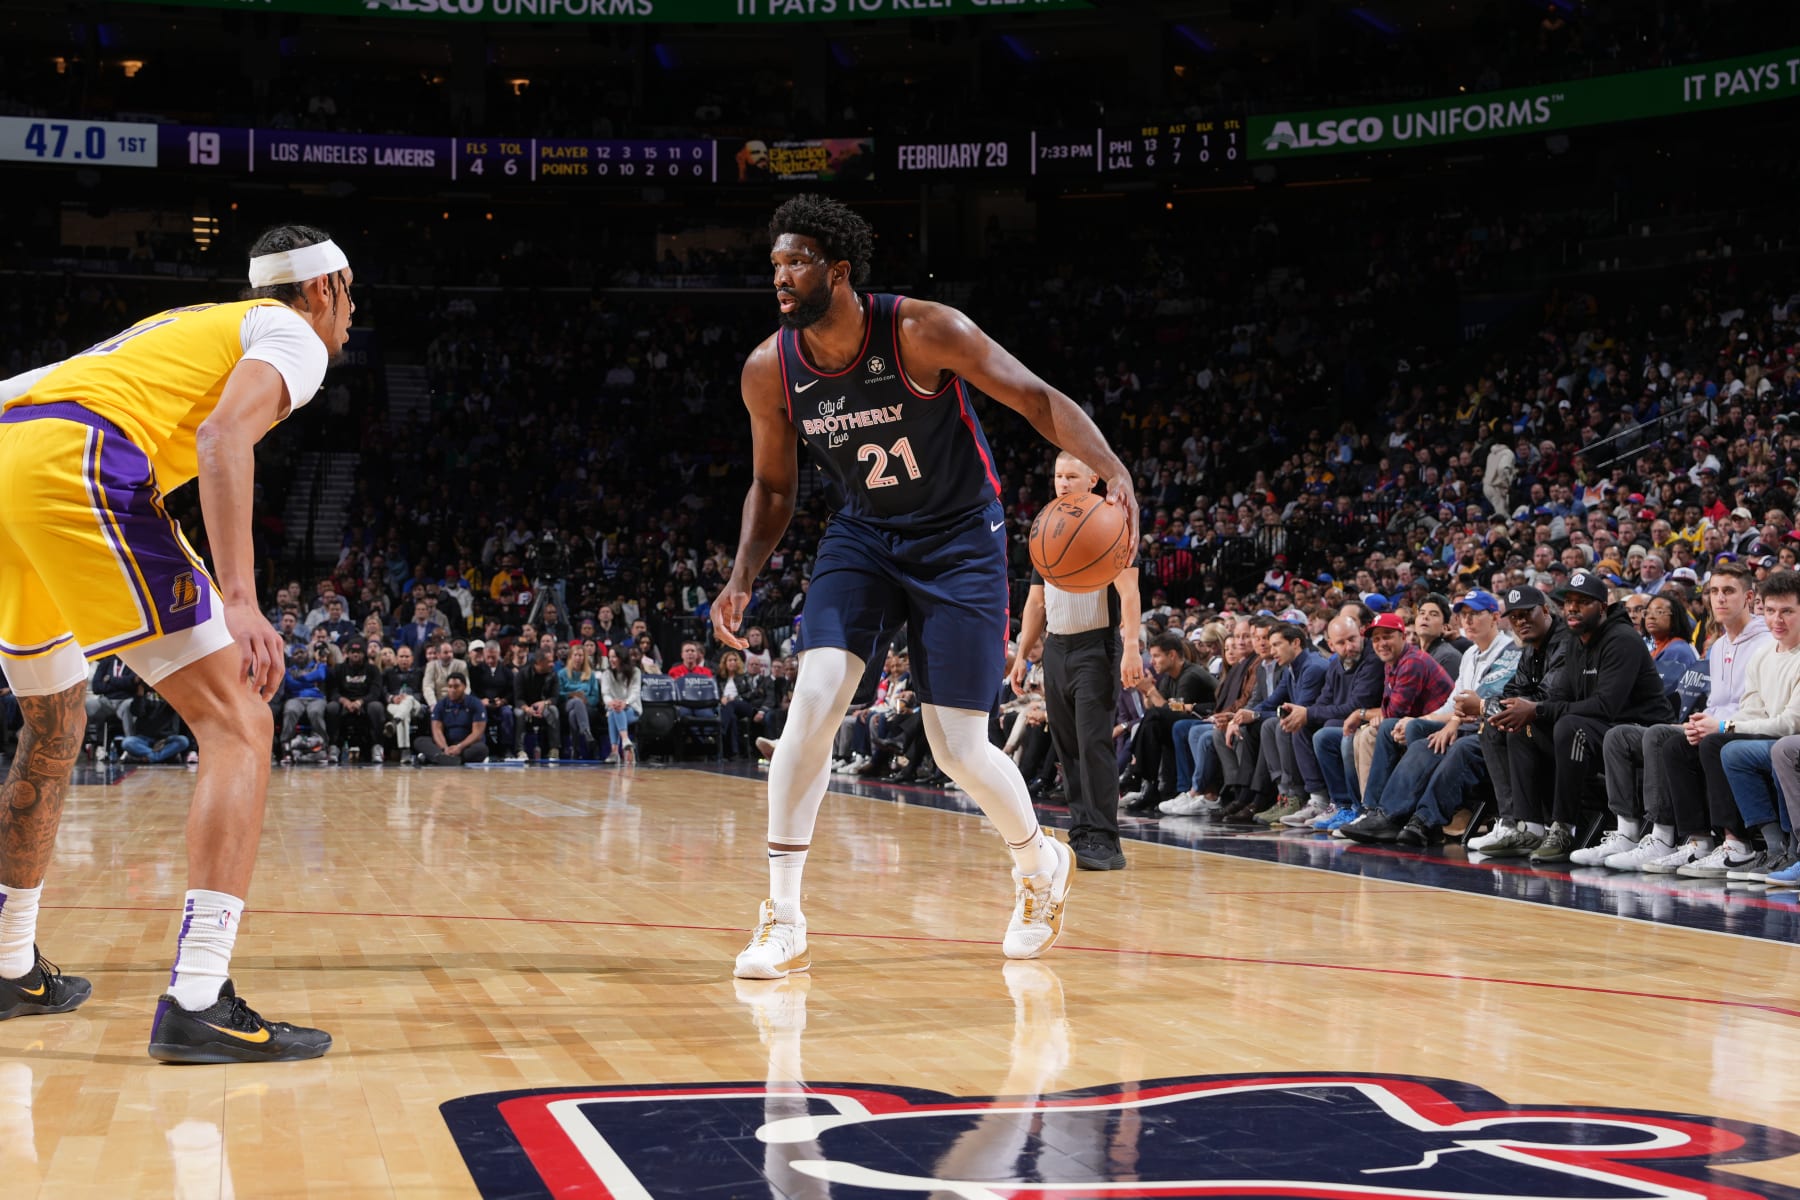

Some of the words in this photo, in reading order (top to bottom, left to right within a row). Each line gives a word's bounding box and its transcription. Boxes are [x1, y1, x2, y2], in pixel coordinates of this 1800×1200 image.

[492, 0, 653, 16] UNIFORMS
[1683, 74, 1706, 102] IT
[1714, 63, 1780, 98] PAYS
[1786, 59, 1800, 85] T
[1168, 124, 1187, 134] AST
[1196, 122, 1214, 132] BLK
[1224, 120, 1241, 129] STL
[1263, 117, 1384, 150] ALSCO
[24, 123, 106, 160] 47.0
[117, 137, 147, 153] 1ST
[187, 131, 221, 165] 19
[466, 143, 488, 155] FLS
[500, 143, 523, 155] TOL
[1040, 146, 1069, 159] 7:33
[1070, 145, 1094, 158] PM
[1109, 140, 1133, 154] PHI
[1144, 138, 1158, 151] 13
[1173, 137, 1182, 149] 7
[1202, 135, 1209, 147] 1
[1229, 132, 1237, 145] 1
[270, 143, 299, 162] LOS
[302, 145, 368, 165] ANGELES
[374, 147, 436, 167] LAKERS
[541, 146, 589, 159] PLAYER
[597, 147, 611, 159] 12
[622, 147, 632, 159] 3
[644, 147, 658, 159] 15
[669, 148, 682, 159] 11
[692, 147, 703, 160] 0
[898, 143, 983, 170] FEBRUARY
[985, 142, 1009, 167] 29
[1108, 156, 1134, 169] LAL
[1146, 155, 1156, 167] 6
[1173, 152, 1182, 164] 7
[1199, 150, 1210, 162] 0
[1227, 148, 1238, 160] 0
[470, 159, 484, 176] 4
[503, 159, 518, 176] 6
[541, 163, 589, 176] POINTS
[598, 164, 609, 176] 0
[619, 163, 635, 176] 10
[645, 163, 656, 176] 2
[668, 164, 679, 176] 0
[693, 164, 703, 177] 0
[864, 374, 896, 385] crypto.com
[818, 400, 836, 420] City
[836, 395, 846, 410] of
[802, 403, 903, 435] BROTHERLY
[828, 431, 850, 449] Love
[857, 436, 922, 490] 21
